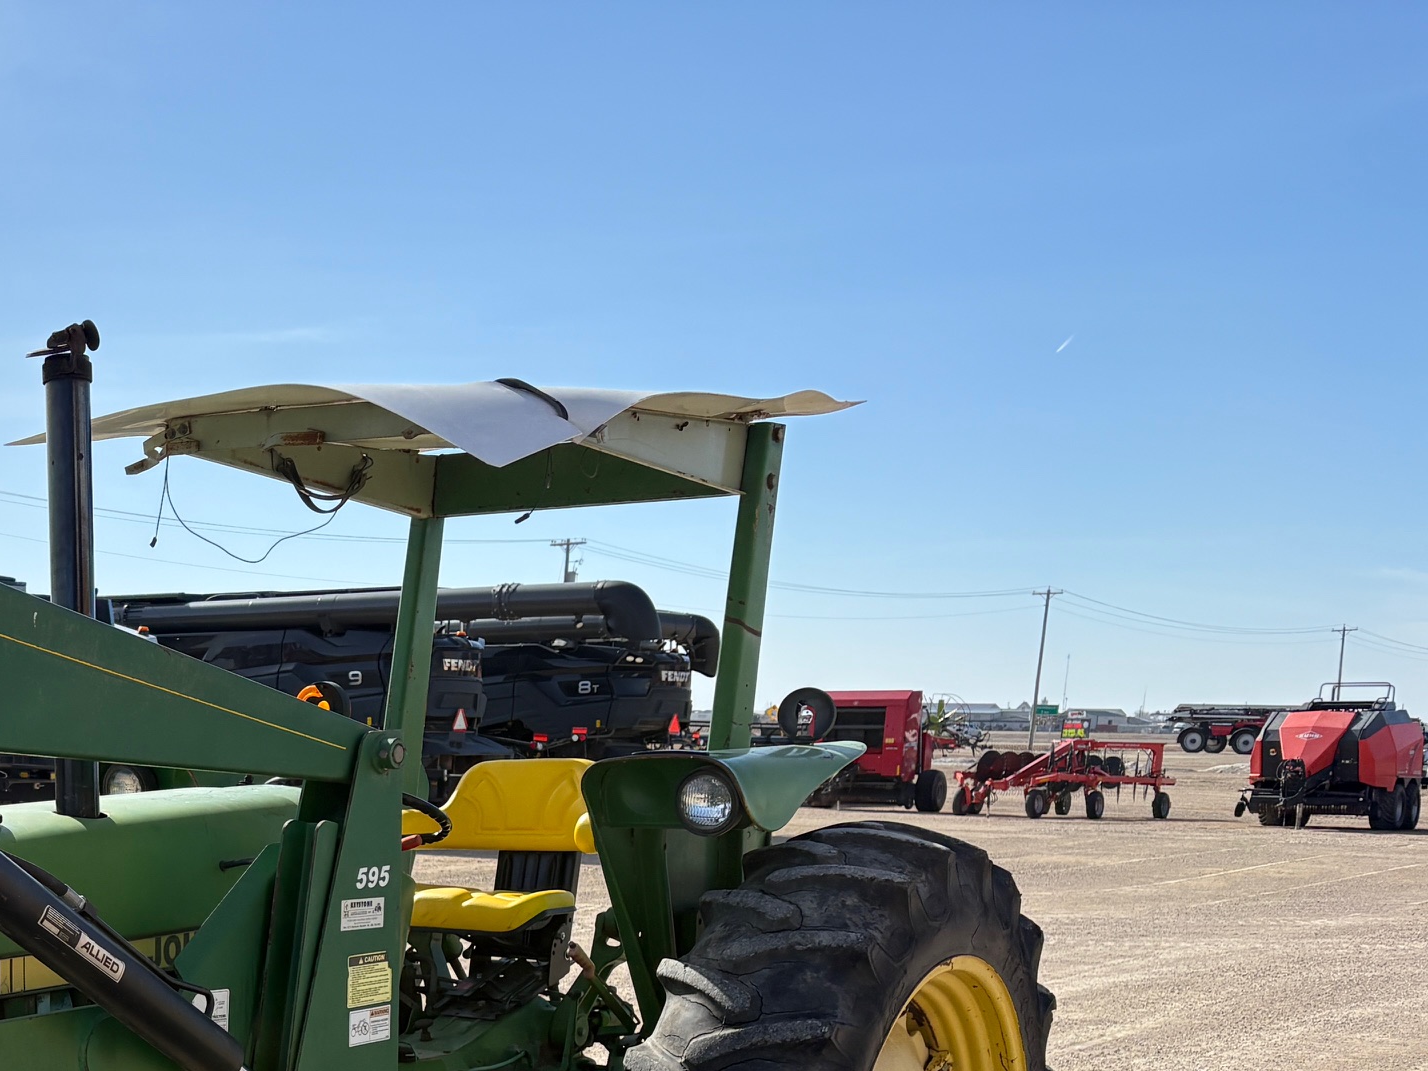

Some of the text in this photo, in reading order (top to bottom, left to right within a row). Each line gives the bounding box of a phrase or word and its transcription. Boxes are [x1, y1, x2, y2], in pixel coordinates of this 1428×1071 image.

[348, 670, 363, 686] 9
[661, 670, 690, 682] FENDT
[355, 865, 391, 890] 595
[80, 941, 120, 975] ALLIED
[364, 954, 386, 963] CAUTION
